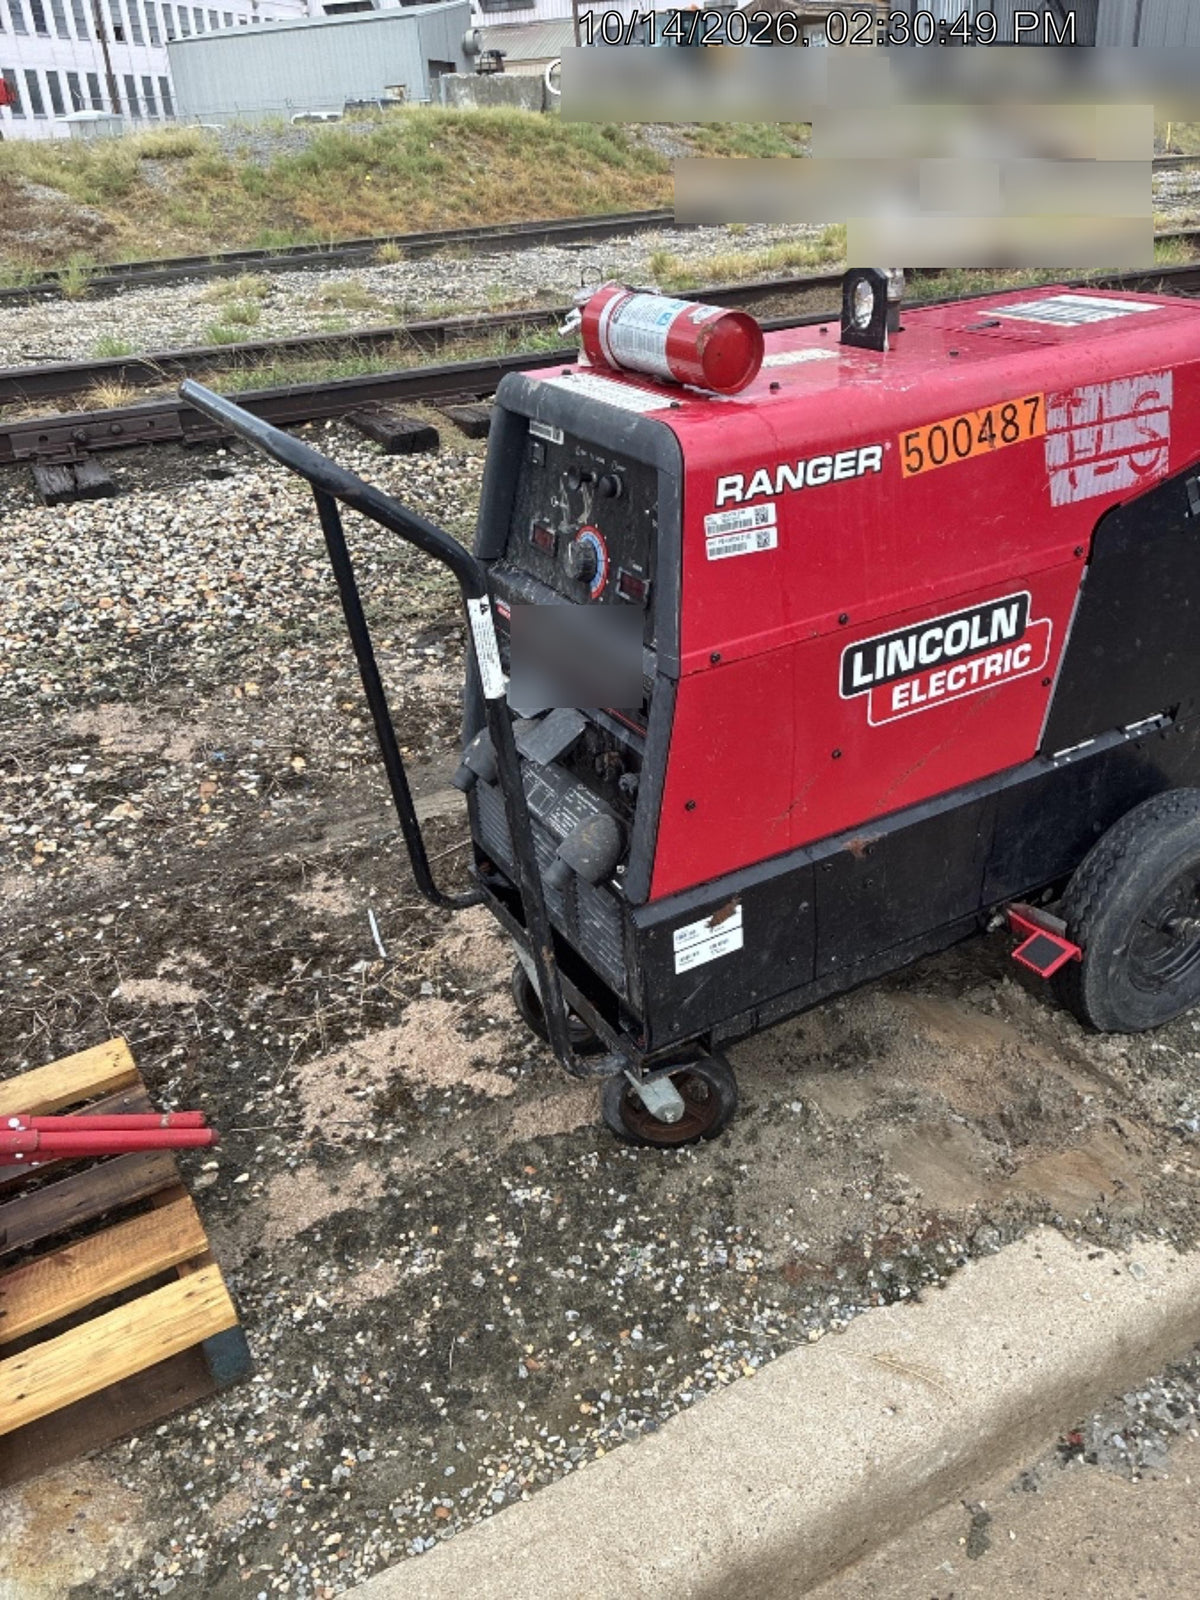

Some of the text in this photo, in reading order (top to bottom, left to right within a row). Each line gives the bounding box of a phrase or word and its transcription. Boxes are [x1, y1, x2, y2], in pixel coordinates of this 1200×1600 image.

[904, 397, 1042, 474] 500487
[715, 445, 883, 507] RANGER
[852, 602, 1019, 688] LINCOLN
[891, 642, 1032, 711] ELECTRIC
